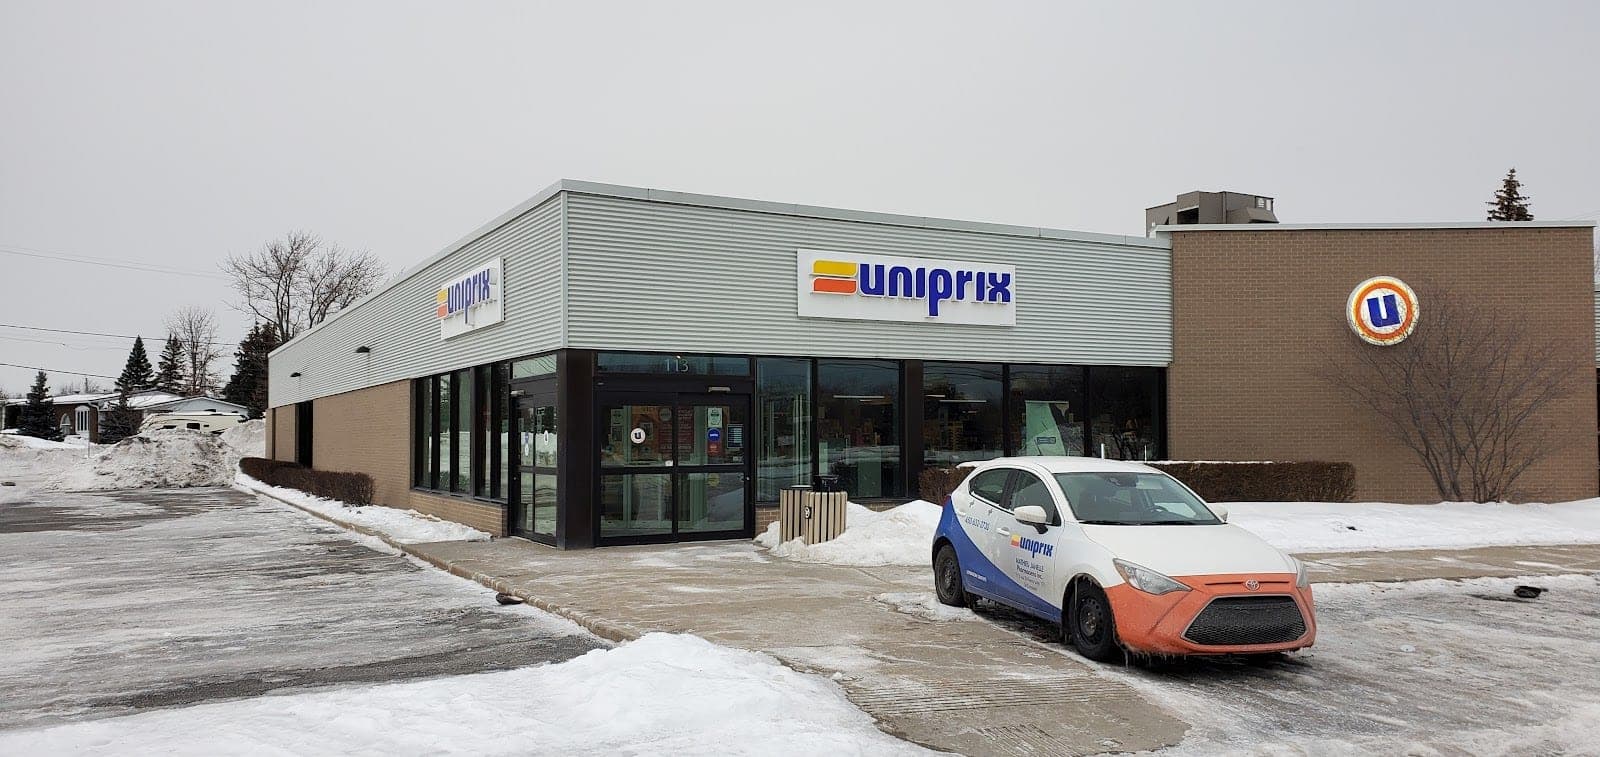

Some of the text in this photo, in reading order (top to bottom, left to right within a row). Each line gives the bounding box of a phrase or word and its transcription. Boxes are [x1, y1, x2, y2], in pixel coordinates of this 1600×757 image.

[860, 263, 1011, 317] uniprix
[665, 358, 689, 372] 113
[1020, 536, 1054, 558] uniprix
